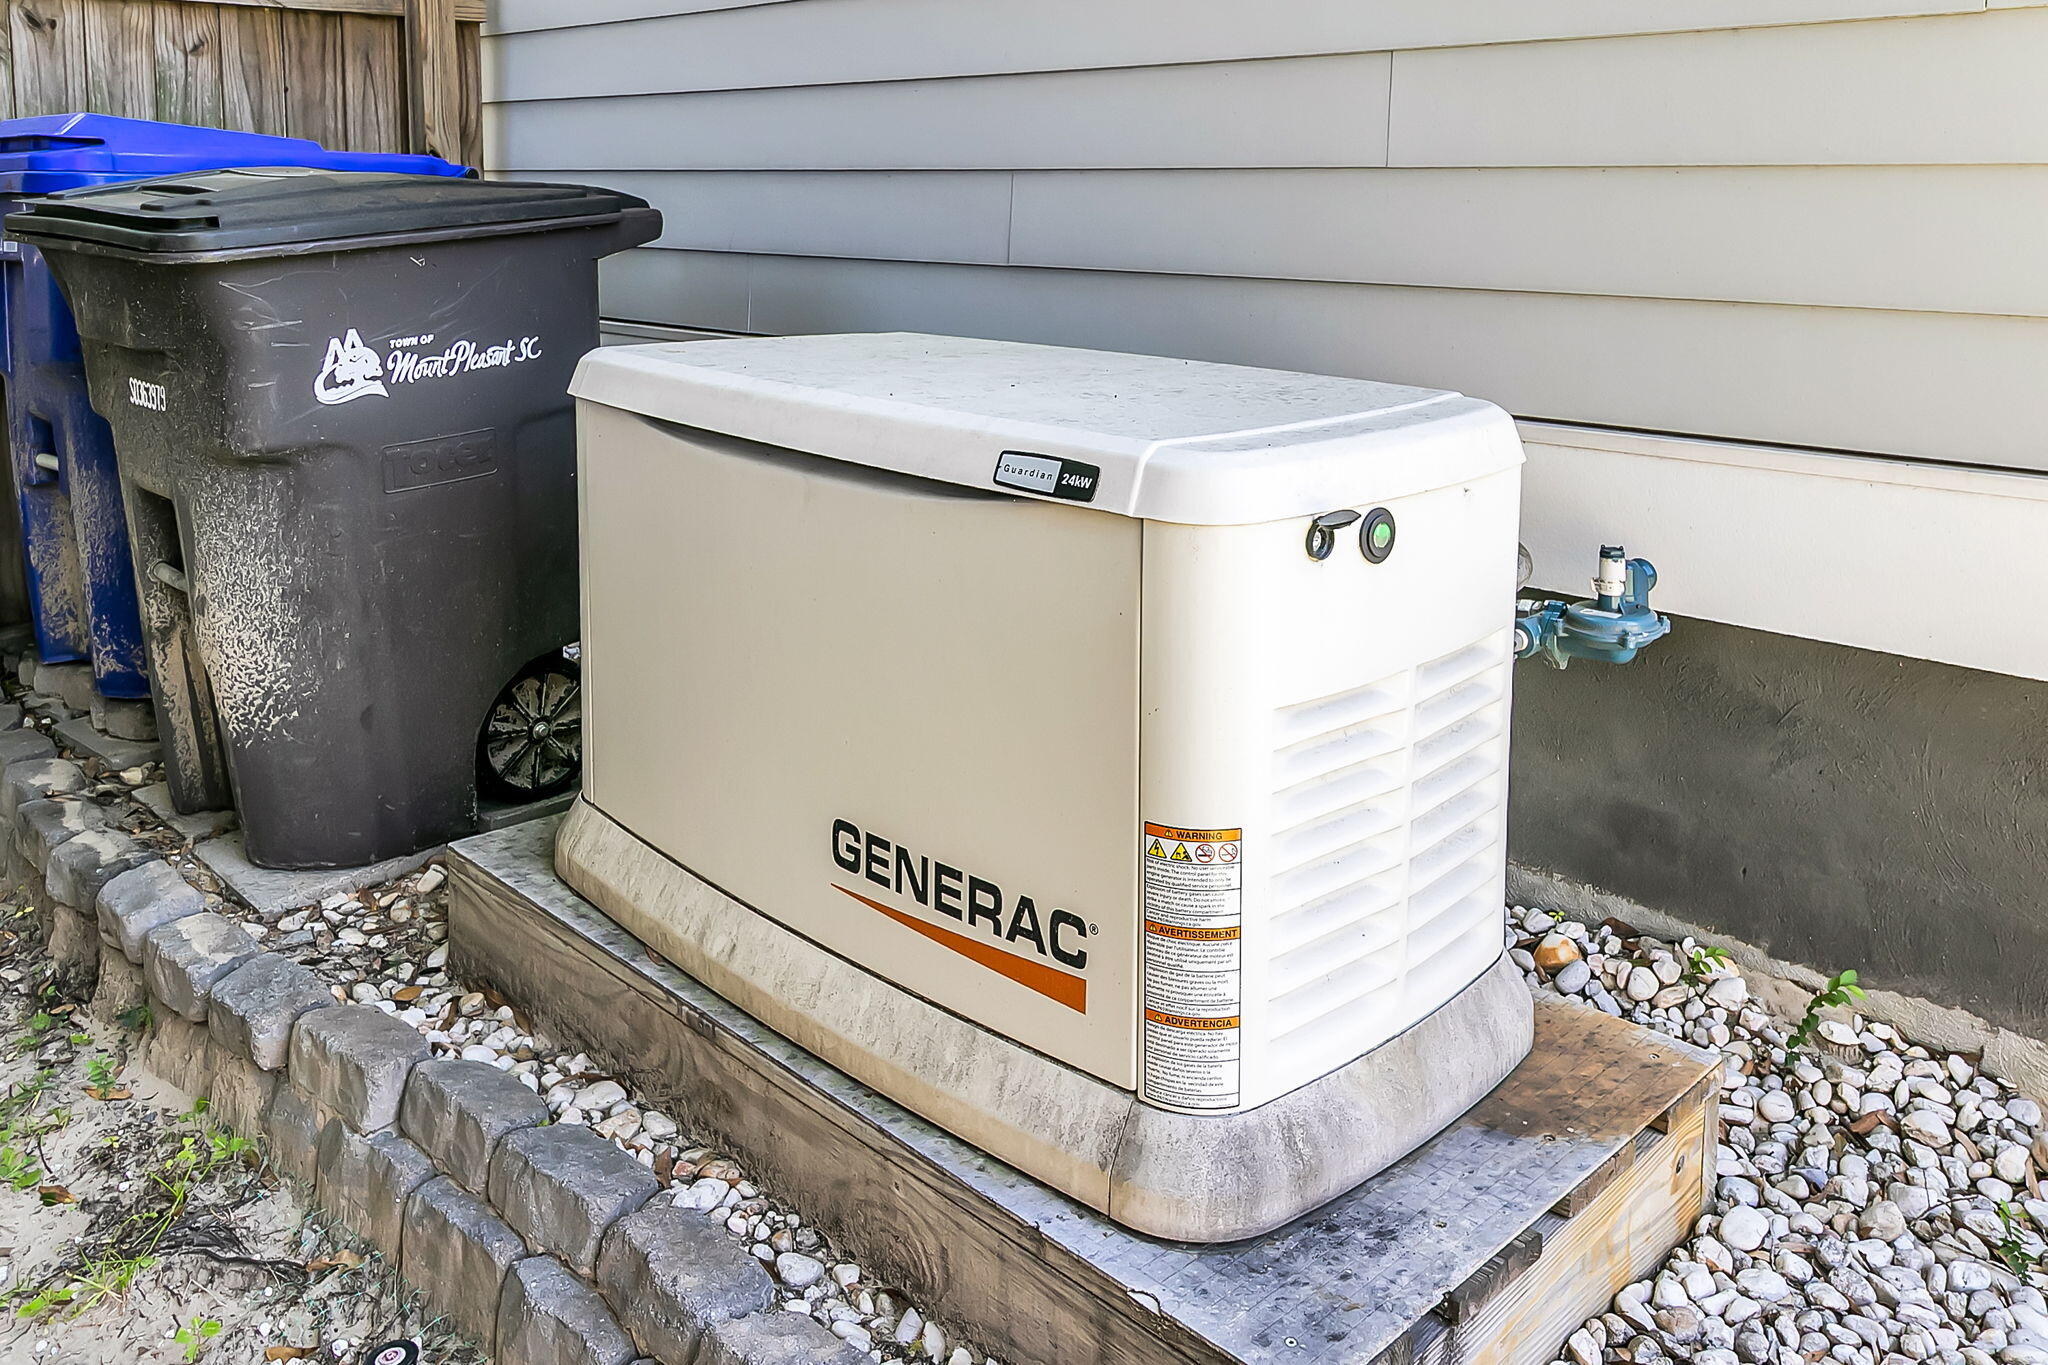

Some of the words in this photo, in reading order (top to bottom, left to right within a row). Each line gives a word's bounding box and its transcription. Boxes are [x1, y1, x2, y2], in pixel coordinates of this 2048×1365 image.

[389, 339, 418, 349] TOWN
[420, 334, 435, 345] OF
[386, 349, 452, 384] Mount
[448, 340, 516, 377] Pleasant
[515, 336, 542, 362] SC
[1003, 464, 1053, 481] Guardian
[1061, 473, 1093, 489] 24kW
[1176, 831, 1223, 840] WARNING
[1158, 926, 1238, 939] AVERTISSEMENT
[1164, 1017, 1233, 1028] ADVERTENCIA
